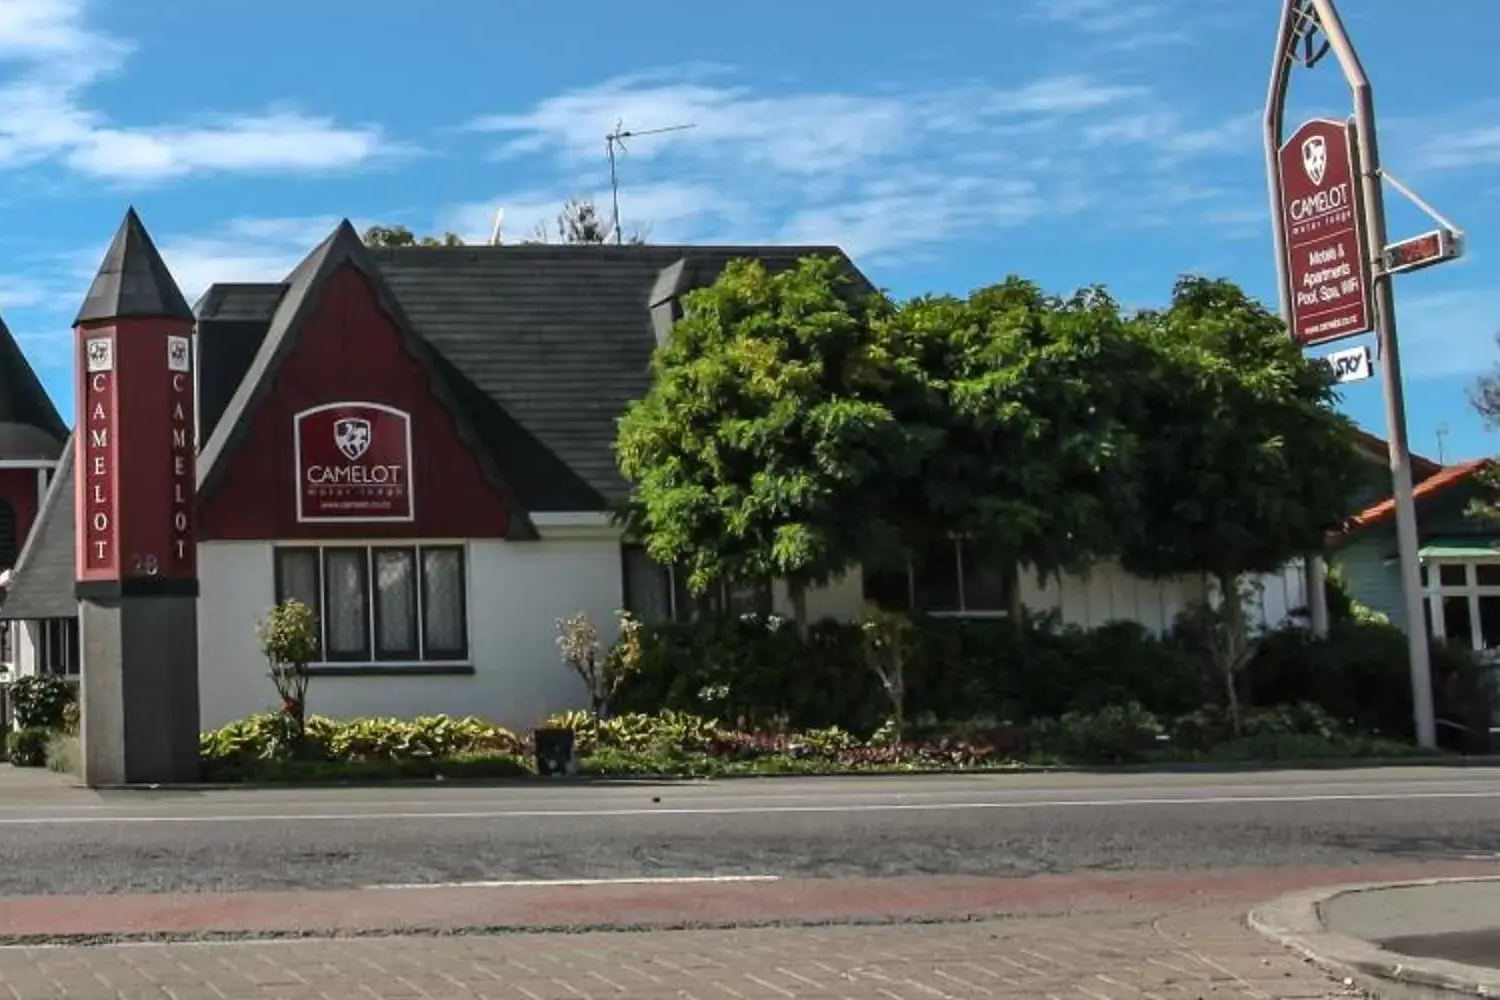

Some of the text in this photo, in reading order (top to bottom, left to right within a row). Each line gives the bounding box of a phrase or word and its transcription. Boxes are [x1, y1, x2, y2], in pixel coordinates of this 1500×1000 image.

[1291, 183, 1348, 220] CAMELOT
[1303, 262, 1351, 288] Apartments
[92, 374, 109, 560] CAMELOT
[172, 374, 188, 559] CAMELOT
[307, 465, 402, 483] CAMELOT
